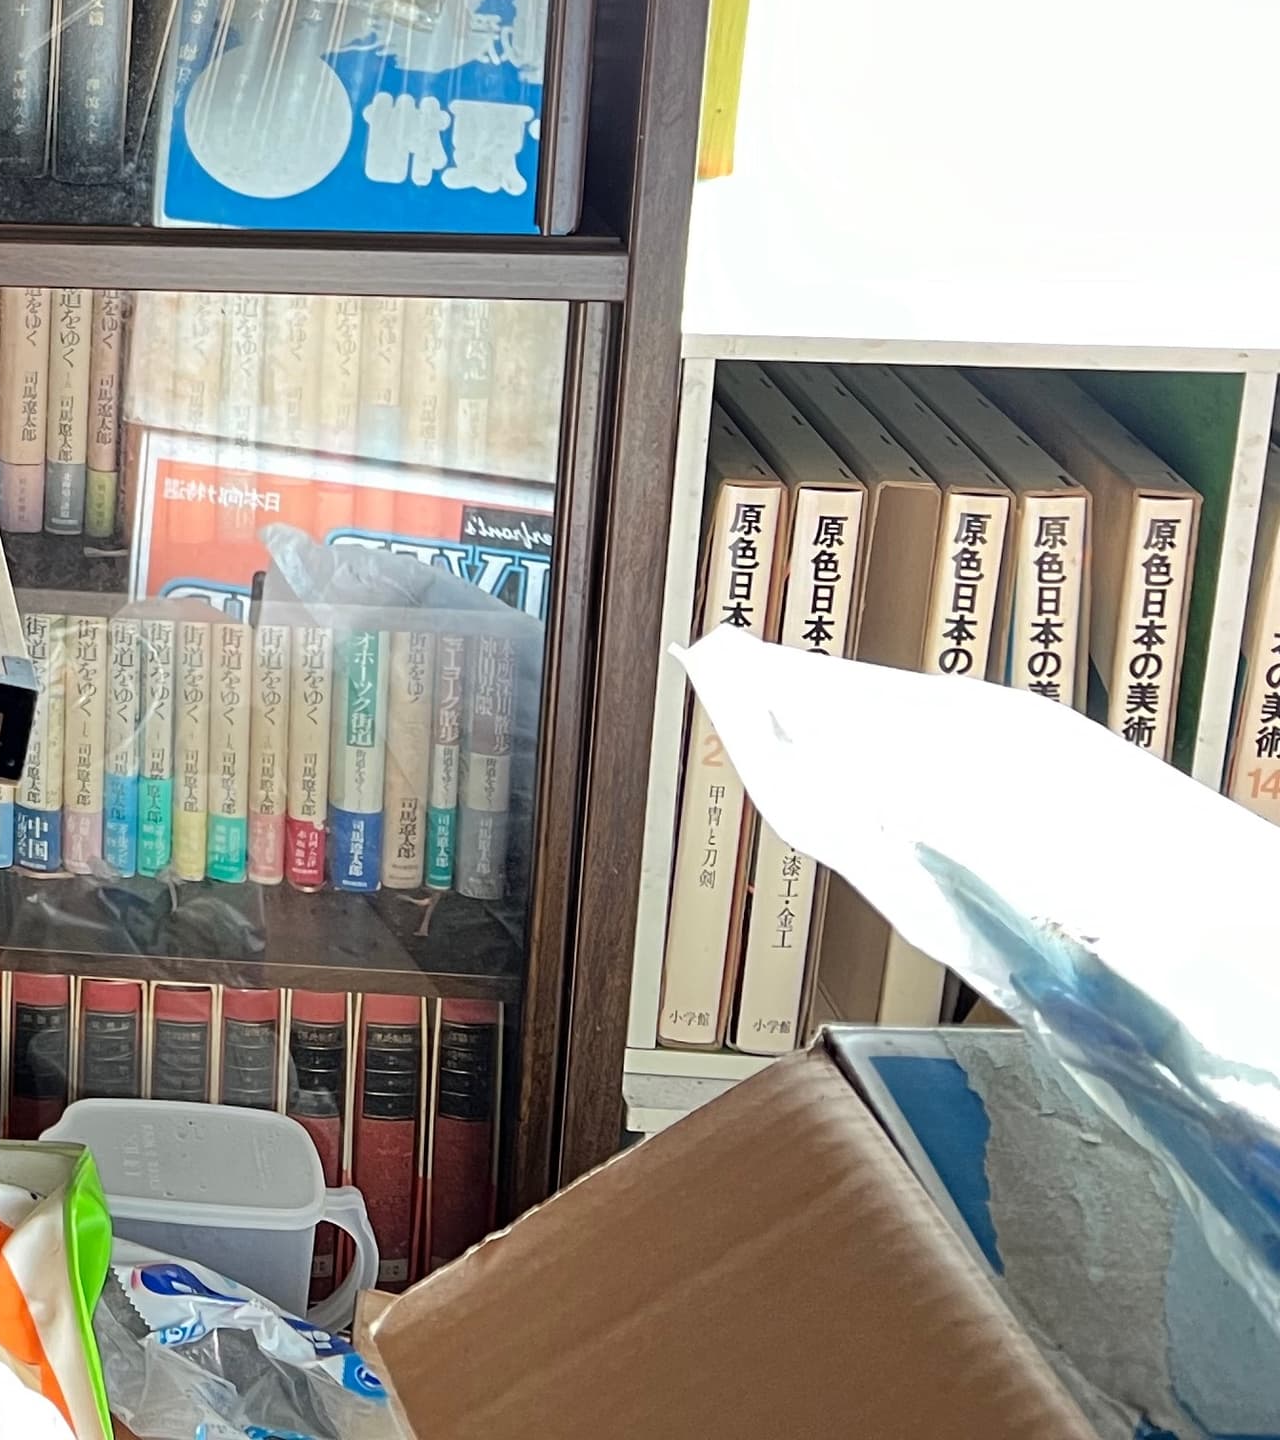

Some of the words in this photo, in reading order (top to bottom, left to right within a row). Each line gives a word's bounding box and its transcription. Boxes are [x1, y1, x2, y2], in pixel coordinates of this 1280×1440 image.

[22, 371, 38, 442] 司馬遼太郎
[96, 374, 114, 445] 司馬遼太郎
[721, 503, 762, 627] 原色日本
[939, 513, 988, 674] 原色日本の
[76, 619, 99, 717] 街道をゆく
[113, 623, 133, 723] 街道をゆく
[148, 623, 172, 717] 街道をゆく
[183, 624, 204, 723] 街道をゆく
[221, 627, 243, 726] 街道をゆく
[259, 627, 284, 725] 街道をゆく
[303, 627, 326, 726] 街道をゆく
[1122, 518, 1178, 748] 原色日本の美術
[350, 632, 377, 747] オホーツク街道
[28, 817, 49, 862] 中国
[397, 797, 418, 859] 司馬遼太郎
[698, 785, 726, 889] 甲冑と刀剣
[668, 1008, 711, 1027] 小学館
[752, 1019, 791, 1035] 小学館
